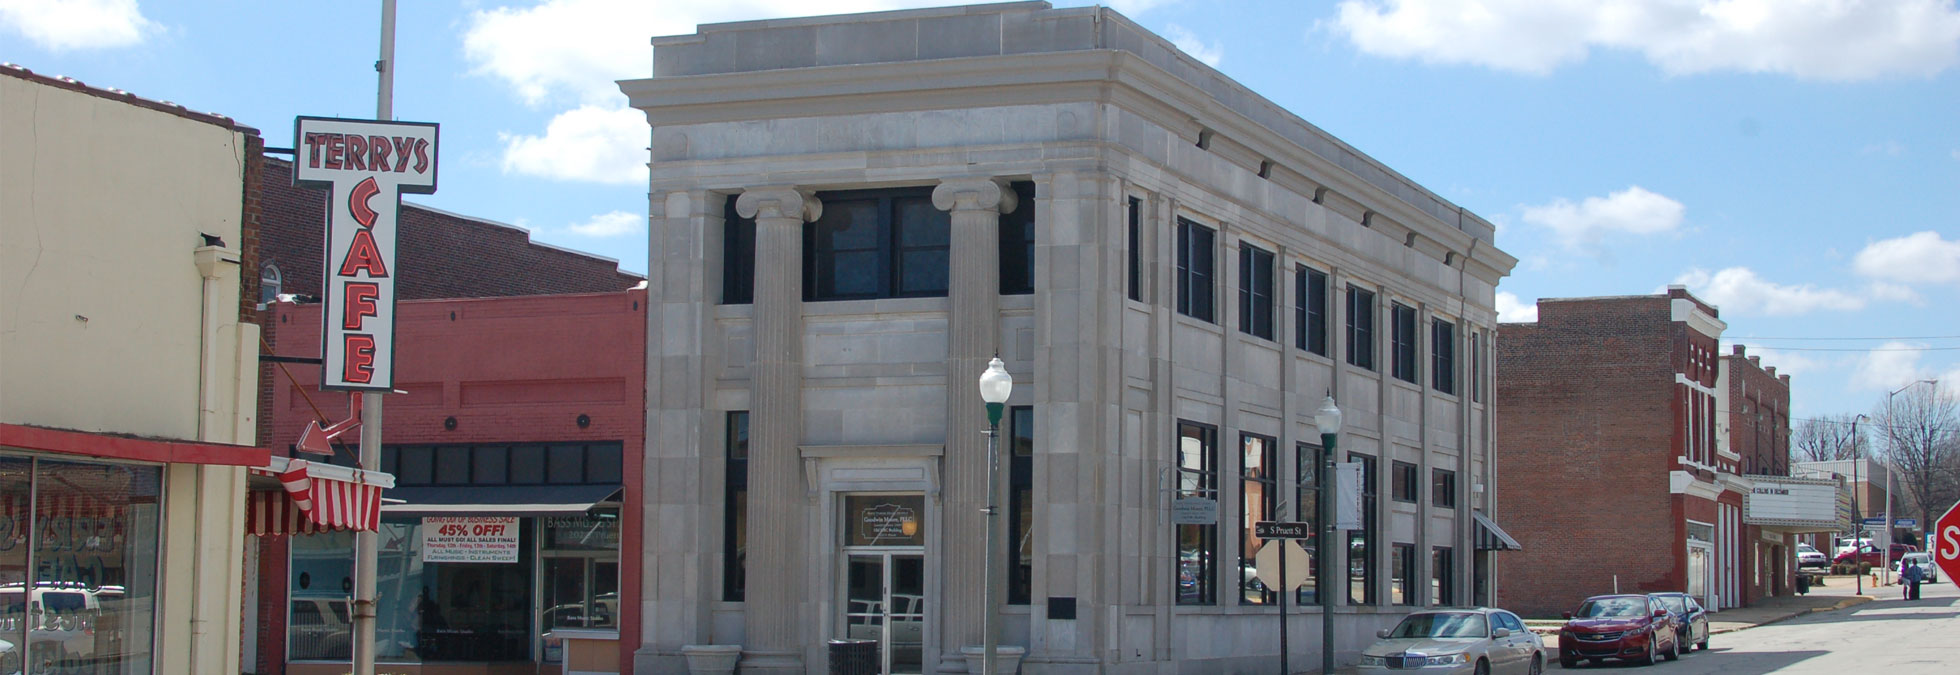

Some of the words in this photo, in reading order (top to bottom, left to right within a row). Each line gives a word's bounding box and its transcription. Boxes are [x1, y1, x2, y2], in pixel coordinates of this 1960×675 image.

[305, 132, 428, 174] TERRYS
[338, 176, 389, 384] CAFE
[548, 516, 571, 528] BASS
[439, 524, 468, 536] 45%
[472, 524, 505, 536] OFF!
[1270, 526, 1274, 534] S
[1295, 527, 1301, 535] St
